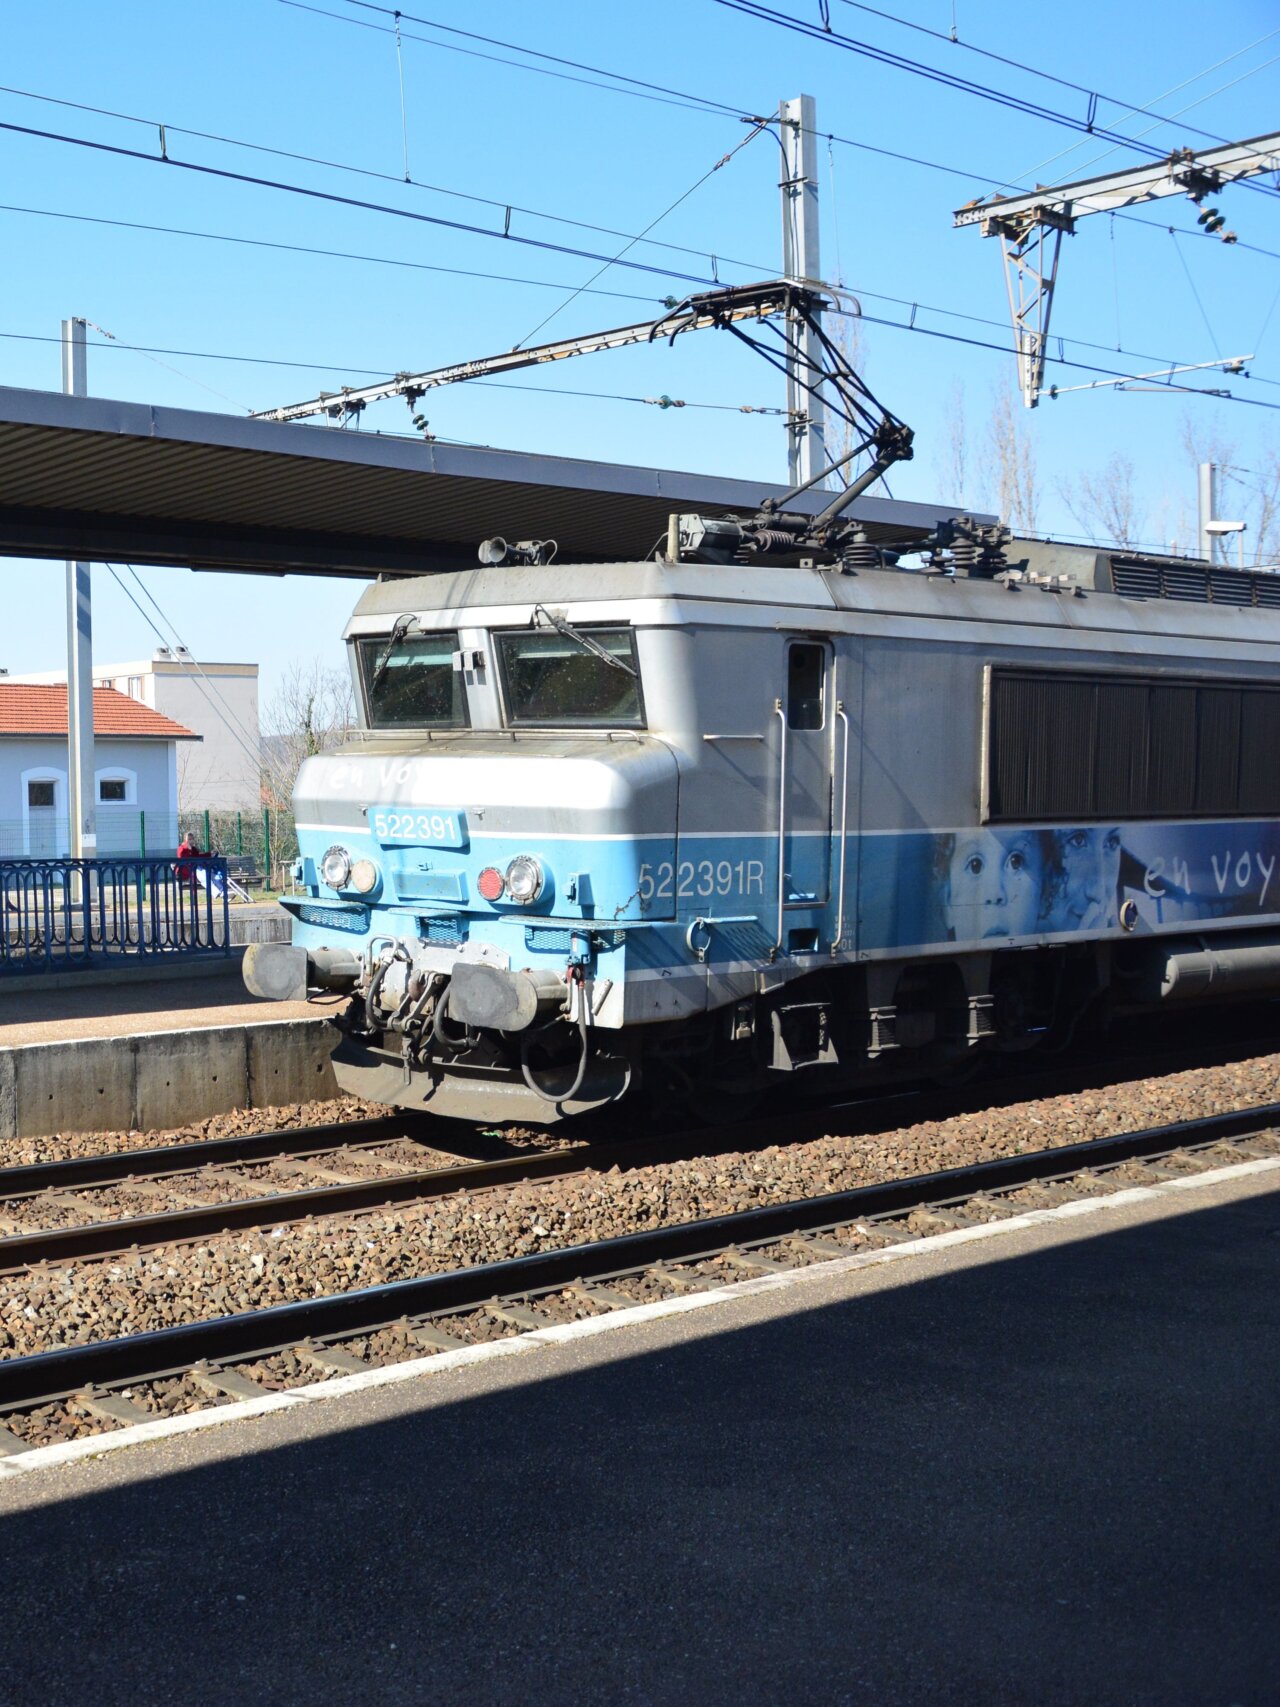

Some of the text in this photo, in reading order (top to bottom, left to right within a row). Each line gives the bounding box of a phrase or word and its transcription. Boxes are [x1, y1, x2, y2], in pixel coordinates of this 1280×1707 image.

[375, 814, 455, 840] 522391
[639, 860, 764, 899] 522391R
[1144, 850, 1276, 906] en voy
